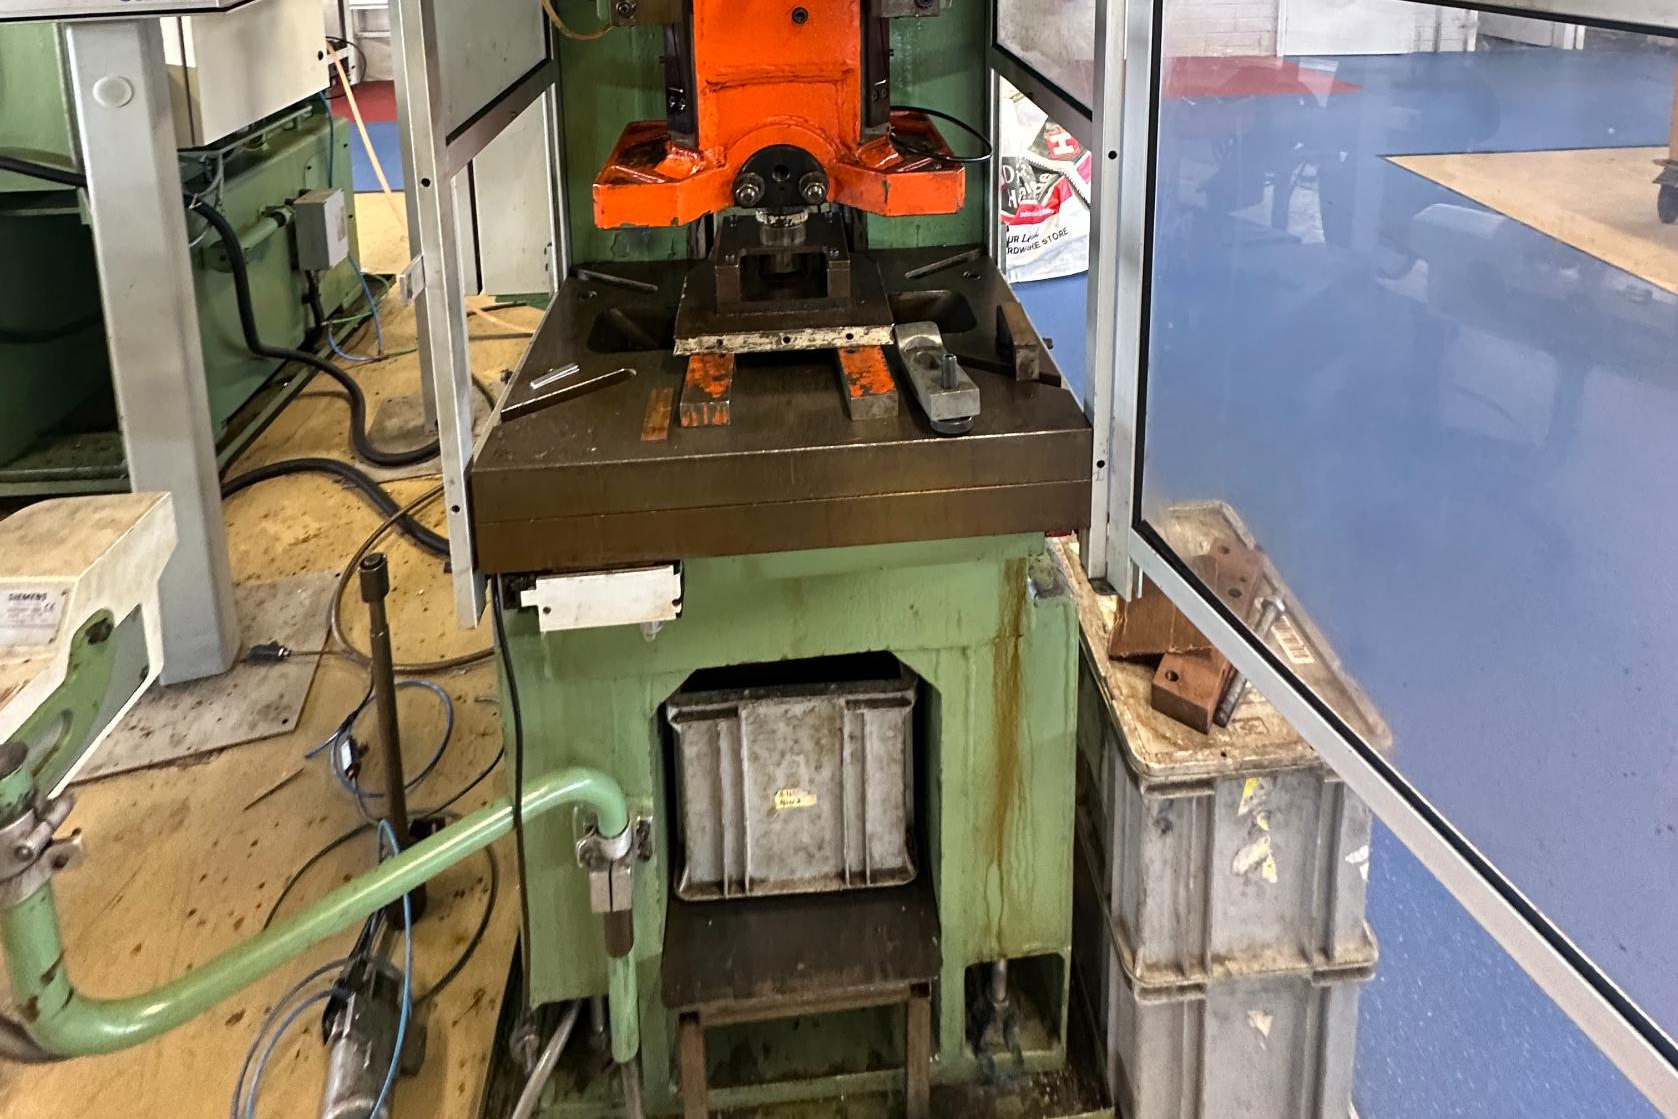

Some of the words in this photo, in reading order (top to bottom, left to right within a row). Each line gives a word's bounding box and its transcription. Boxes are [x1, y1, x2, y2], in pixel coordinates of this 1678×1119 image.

[1007, 235, 1020, 244] UR
[1042, 227, 1069, 245] STORE
[8, 592, 48, 601] SIEMENS
